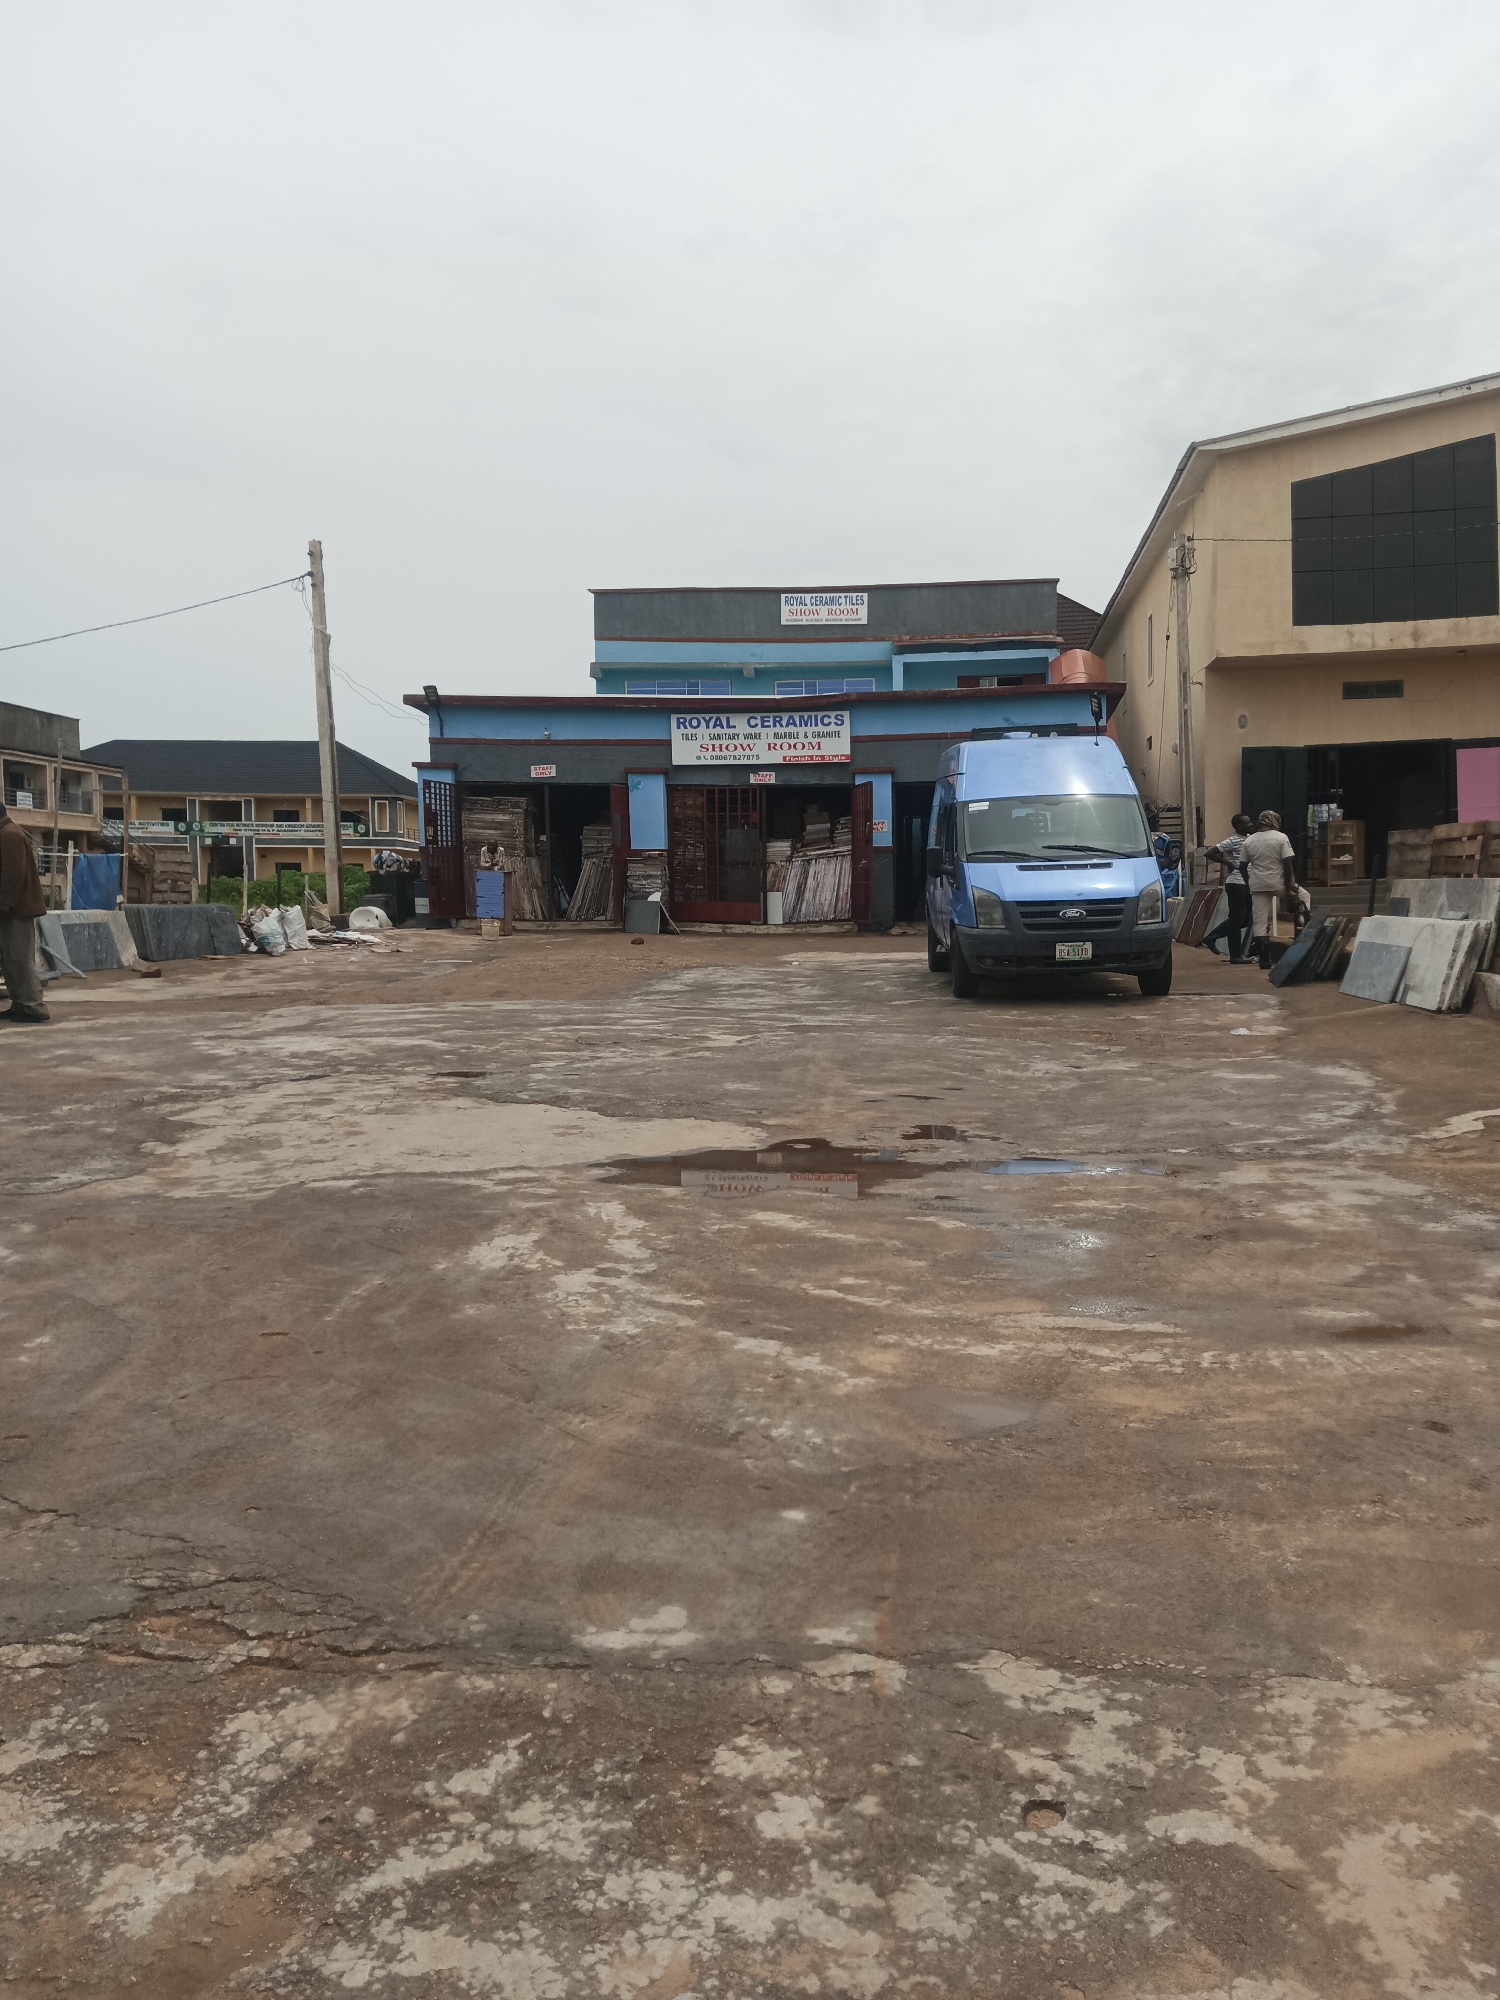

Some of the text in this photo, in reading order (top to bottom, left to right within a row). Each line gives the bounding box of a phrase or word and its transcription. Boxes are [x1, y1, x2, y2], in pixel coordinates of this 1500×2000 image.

[784, 594, 865, 607] ROYAL CERAMIC TILES
[788, 608, 859, 617] SHOW ROOM
[675, 713, 845, 730] ROYAL CERAMICS
[681, 730, 841, 741] TILES SANITARY WARE MARBLE & GRANITE
[699, 741, 823, 753] SHOW ROOM
[824, 754, 846, 762] Style
